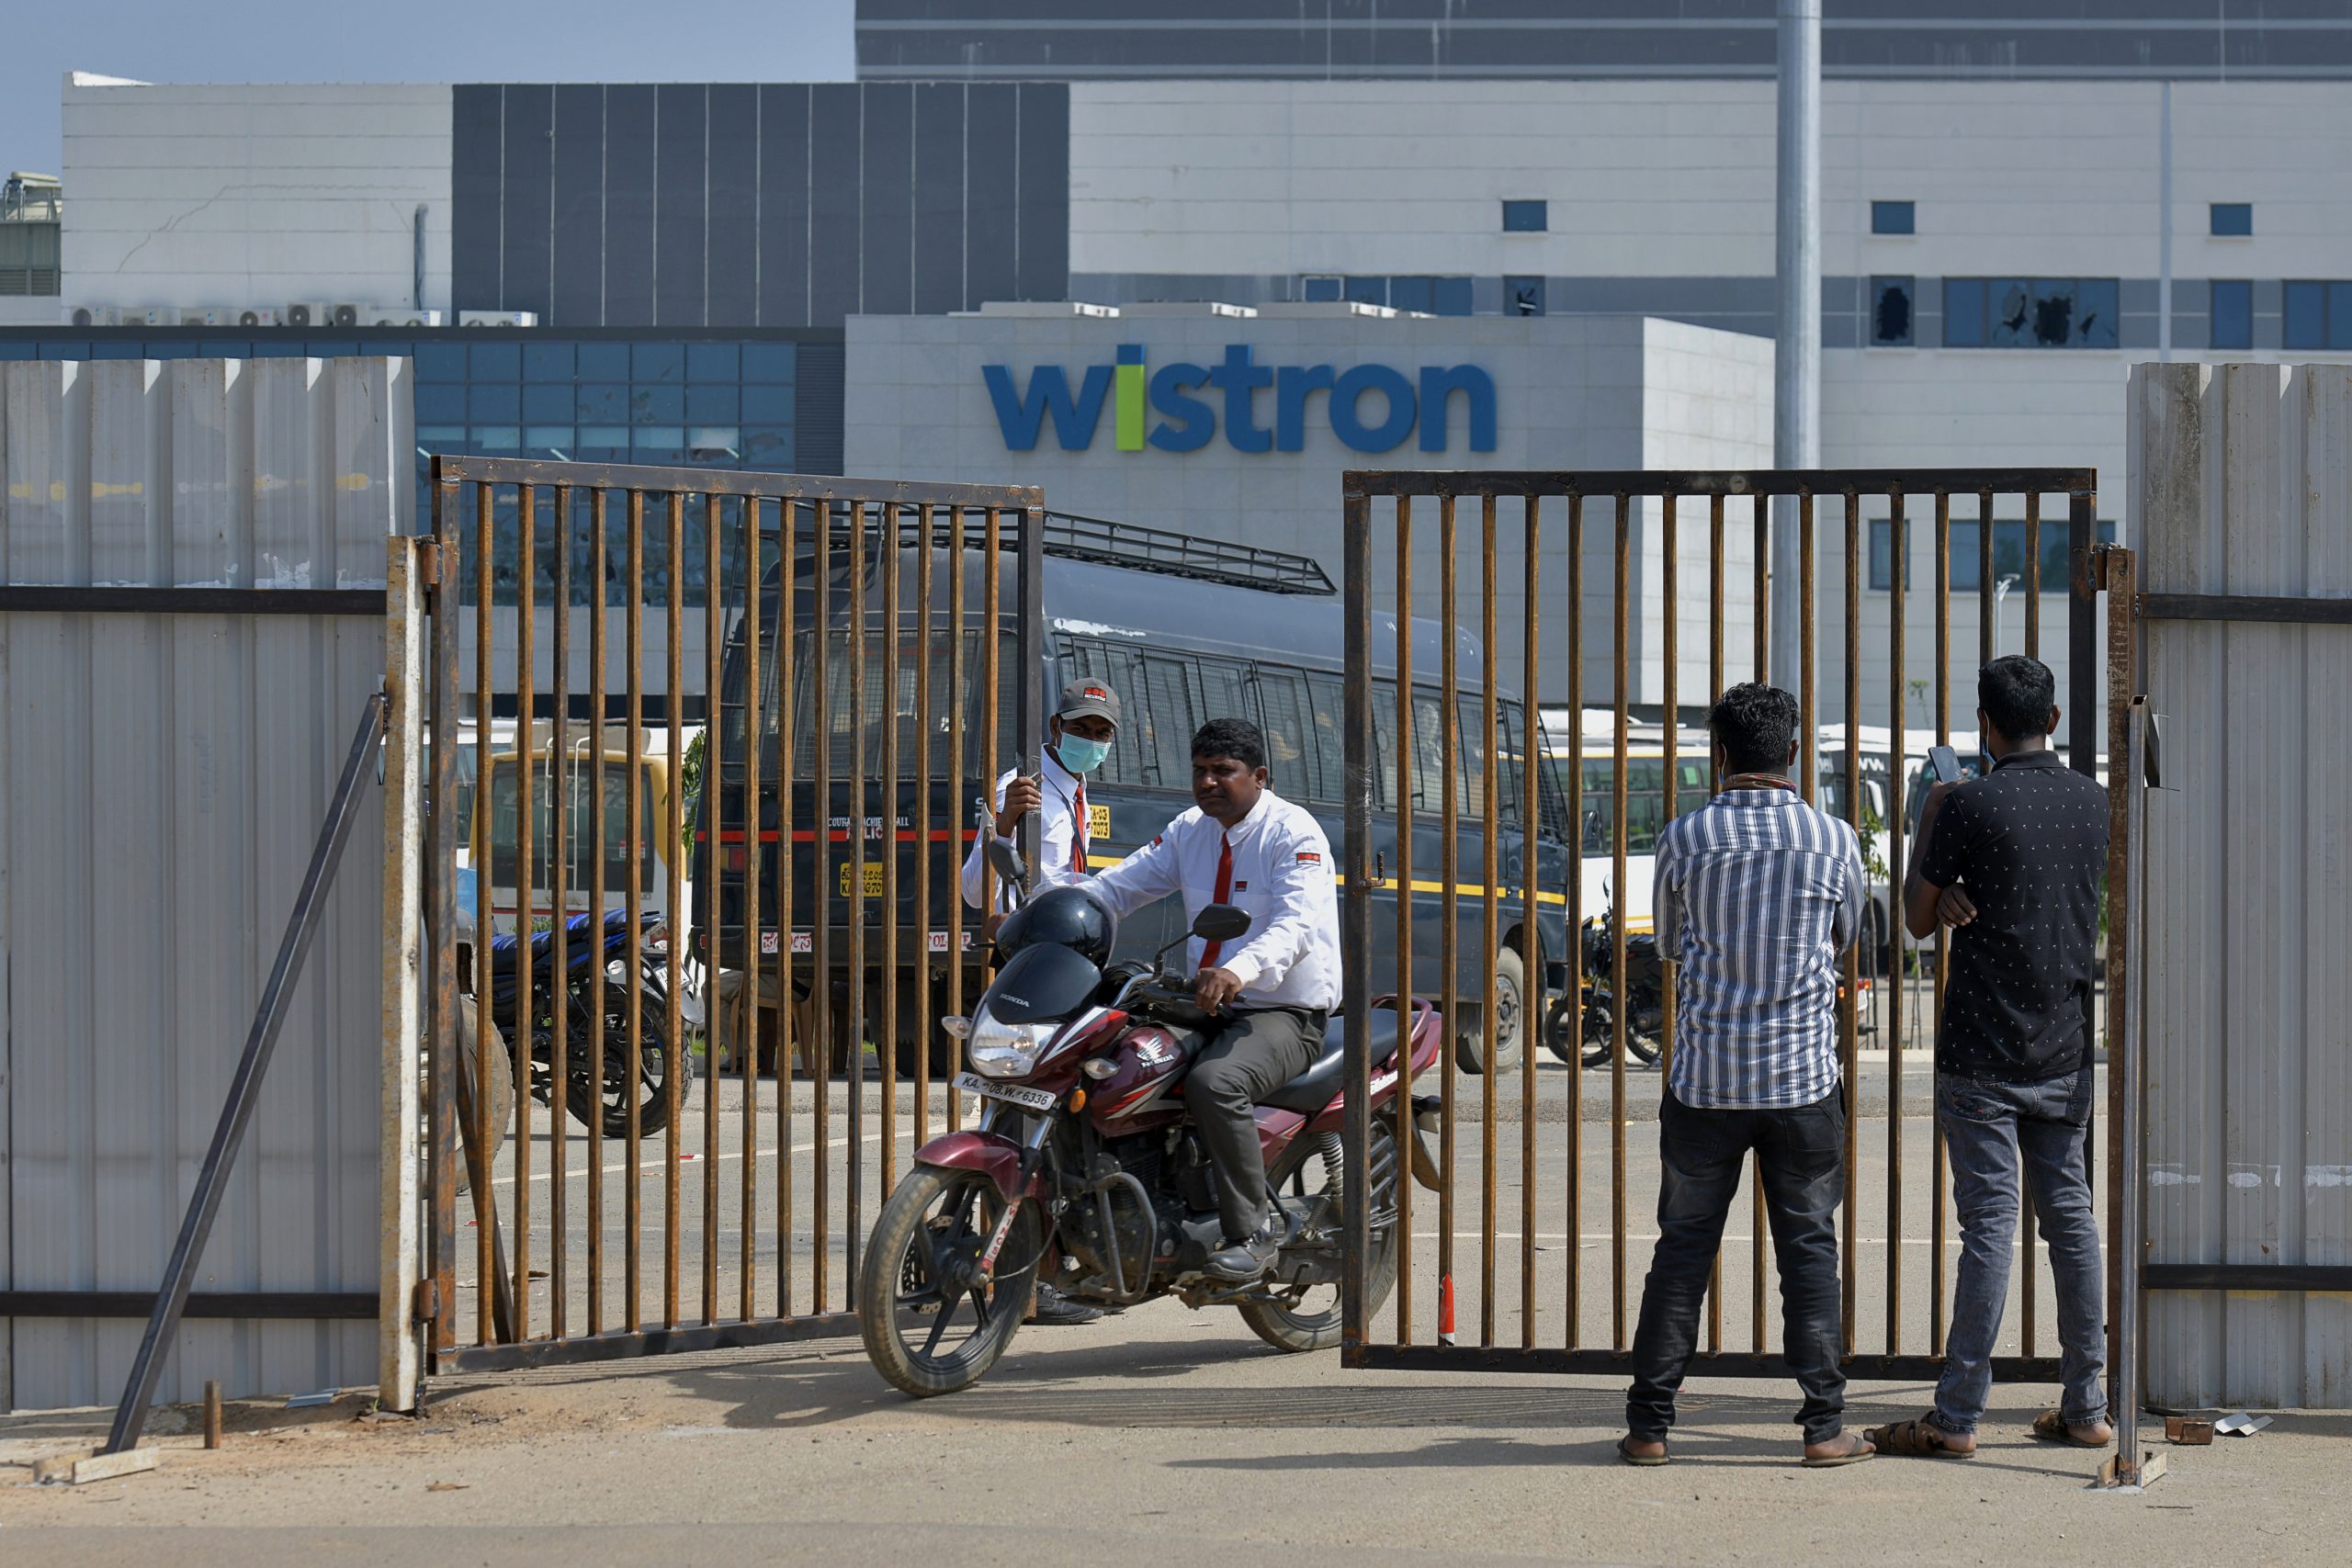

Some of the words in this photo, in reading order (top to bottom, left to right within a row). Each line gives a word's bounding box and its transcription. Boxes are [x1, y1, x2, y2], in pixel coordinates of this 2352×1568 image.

[981, 344, 1498, 453] wistron
[1091, 822, 1108, 836] 7073
[1000, 993, 1029, 1007] HONDA
[1141, 1054, 1174, 1067] HONDA
[1022, 1090, 1049, 1106] 6336
